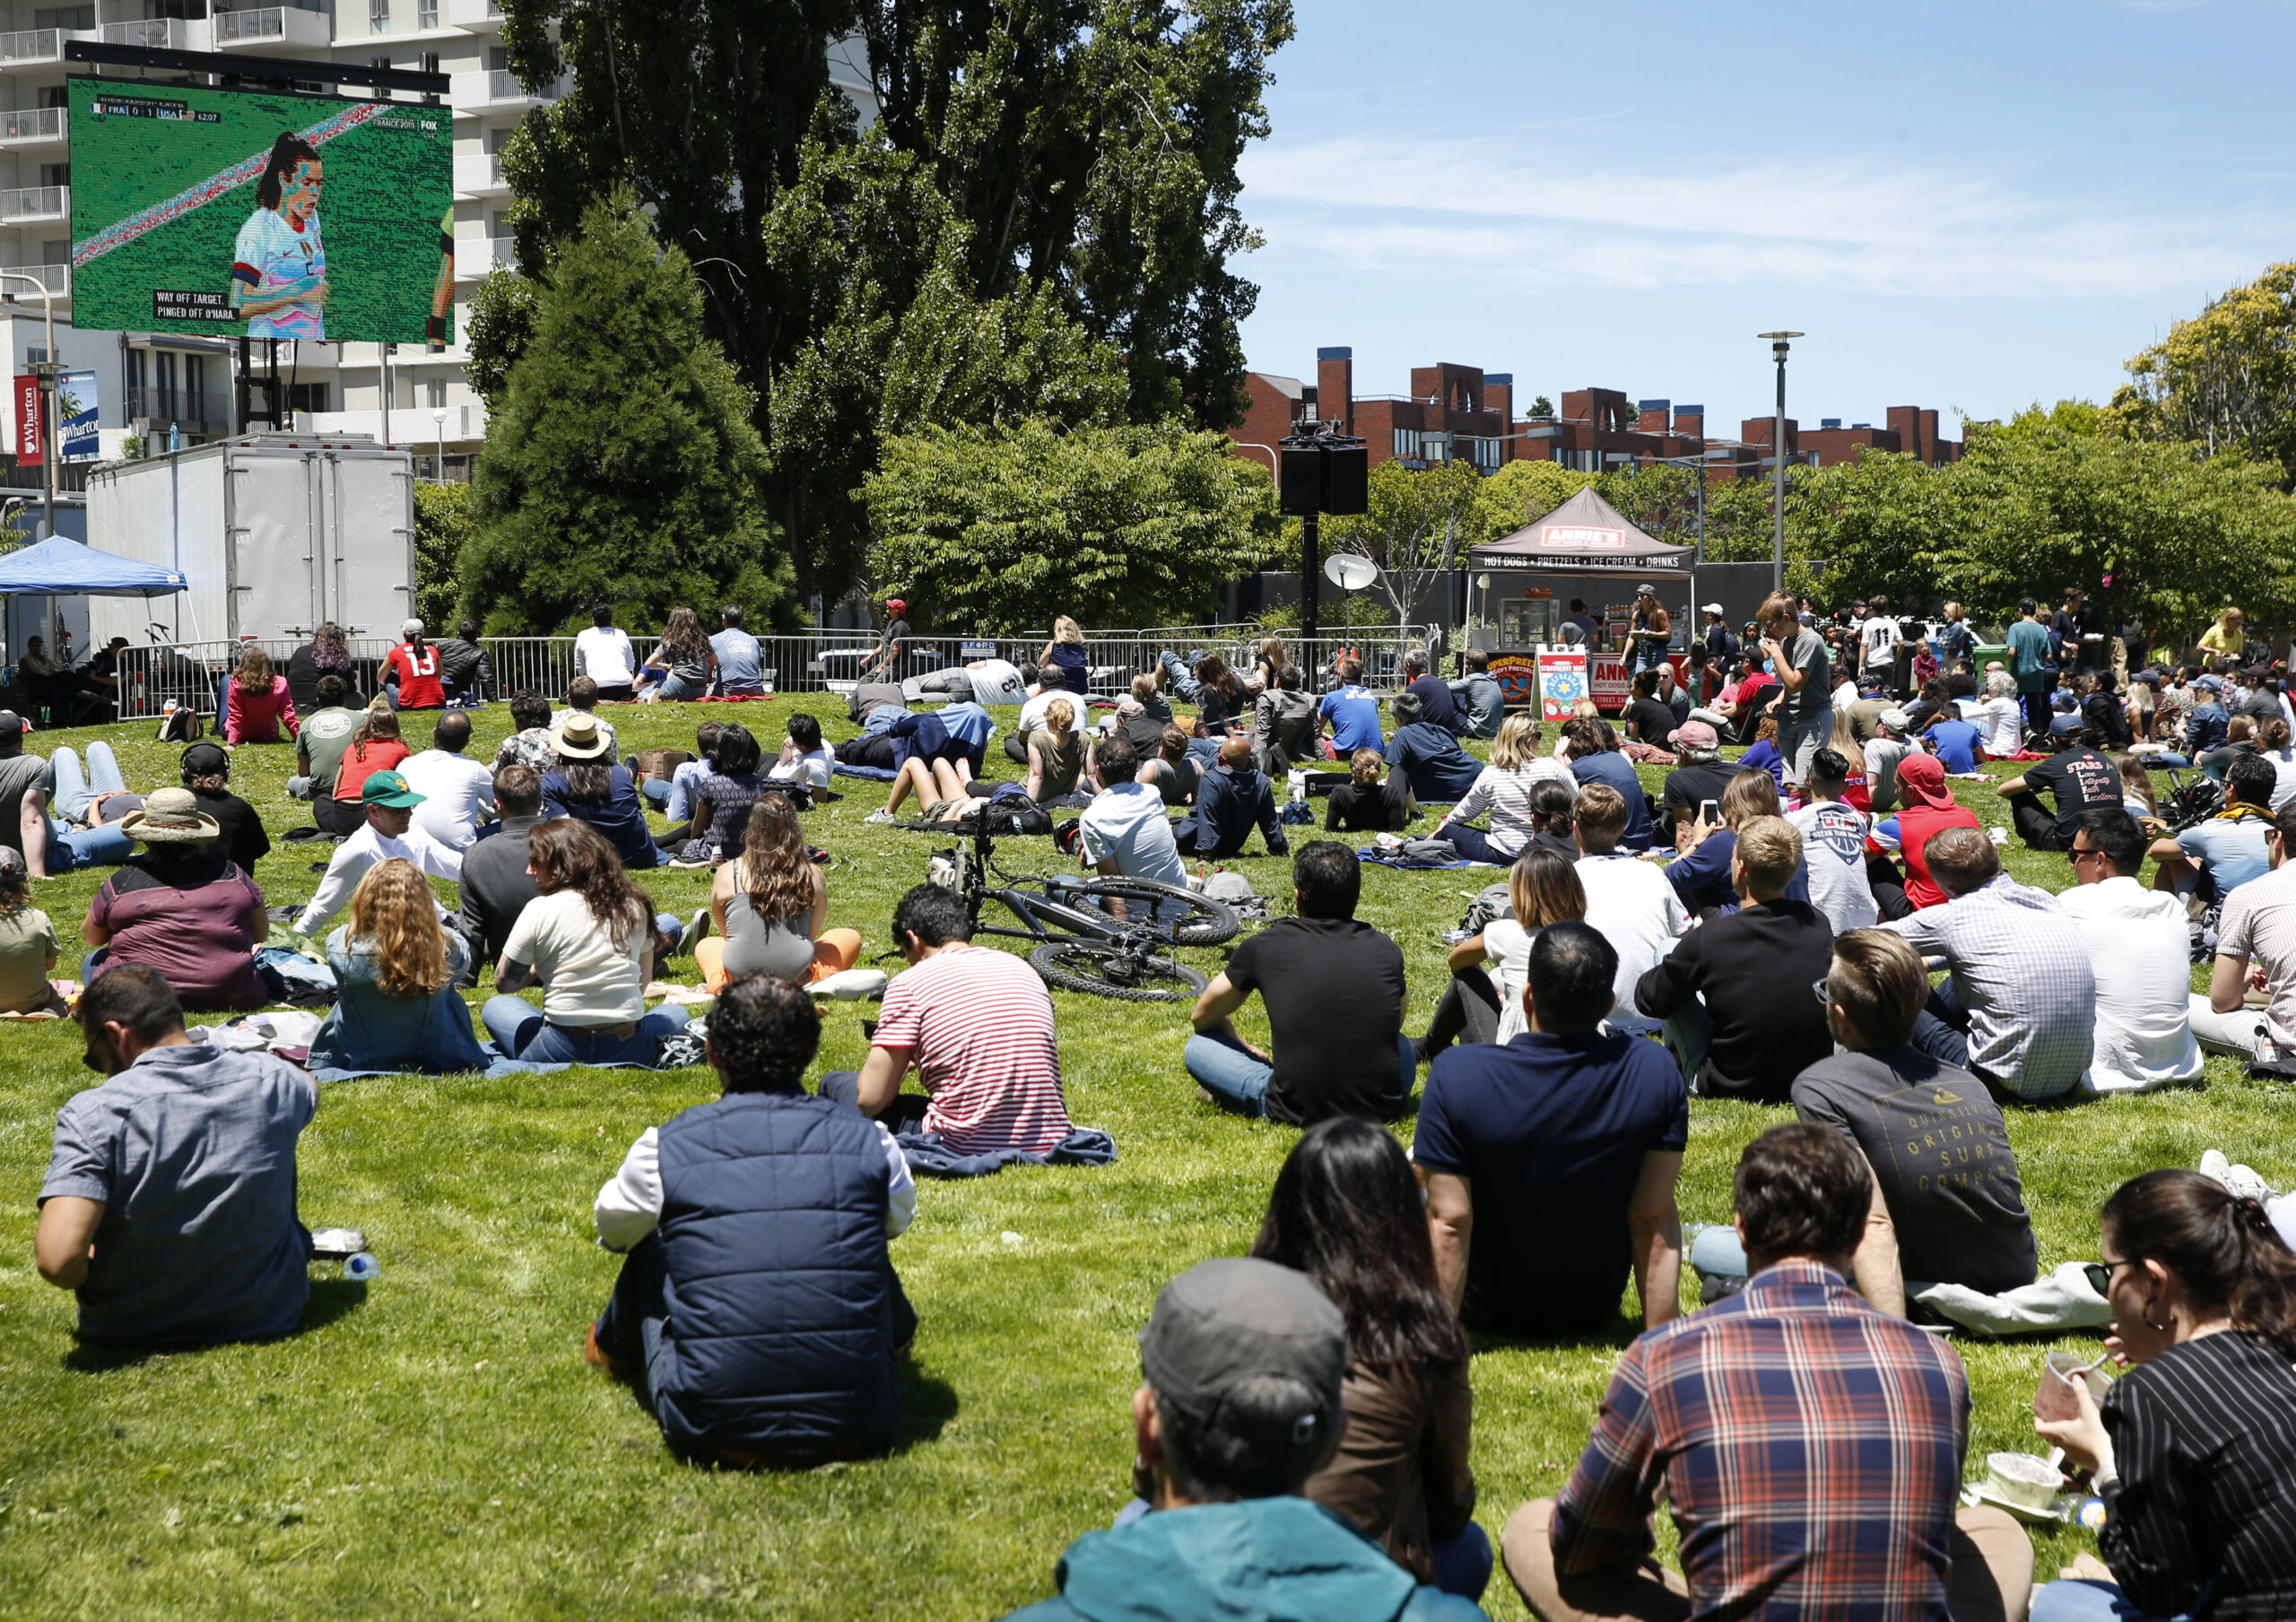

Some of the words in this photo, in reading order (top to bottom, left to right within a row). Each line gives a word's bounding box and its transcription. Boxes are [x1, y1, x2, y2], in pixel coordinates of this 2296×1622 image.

[109, 106, 126, 115] FRA
[148, 108, 152, 117] 1
[161, 110, 177, 118] USA
[197, 114, 217, 122] 62:07
[421, 120, 438, 130] FOX
[156, 292, 174, 302] WAY
[176, 292, 190, 303] OFF
[194, 294, 224, 305] TARGET.
[158, 307, 187, 317] PINGED
[188, 308, 203, 318] OFF
[205, 308, 236, 319] O'HARA.
[23, 387, 34, 442] Wharton
[1548, 528, 1618, 542] ANNIE'S
[1484, 556, 1501, 567] HOT
[1503, 556, 1528, 567] DOGS
[1538, 557, 1580, 567] PRETZELS
[1590, 558, 1604, 568] ICE
[1606, 558, 1636, 568] CREAM
[1647, 556, 1679, 568] DRINKS
[1874, 628, 1889, 646] 11
[405, 653, 436, 677] 13
[1487, 655, 1535, 671] UPERPRET
[1493, 666, 1507, 674] SOFT
[1595, 663, 1629, 681] ANN
[1002, 679, 1017, 693] 8
[2066, 760, 2104, 774] STARS
[2079, 776, 2110, 785] Integrity
[2081, 785, 2100, 794] Faith
[2083, 793, 2118, 802] Excellence
[1813, 829, 1833, 838] DREAM
[1909, 1104, 1992, 1128] QUIKSILVER
[1940, 1142, 1995, 1167] SURF
